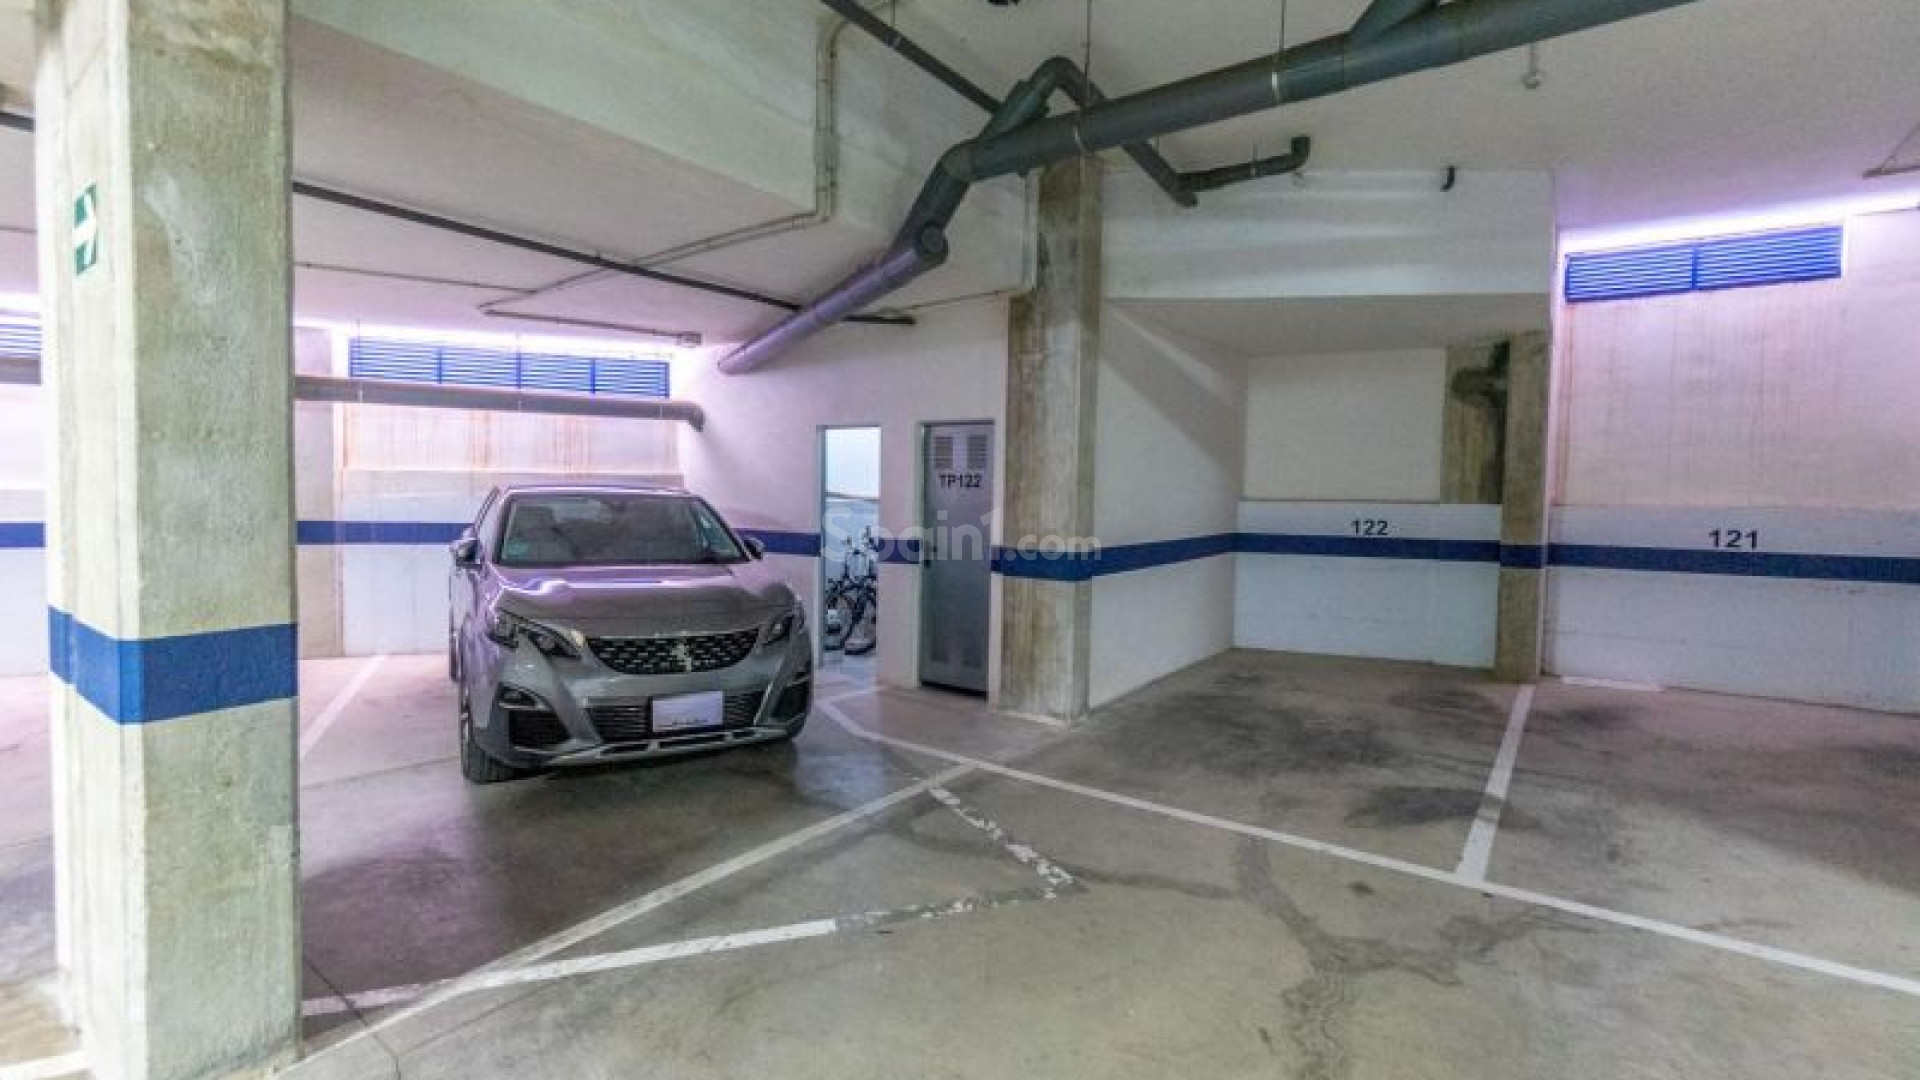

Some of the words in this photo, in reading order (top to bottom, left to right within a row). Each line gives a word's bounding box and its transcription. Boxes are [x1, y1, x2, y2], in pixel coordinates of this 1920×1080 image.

[939, 474, 982, 488] TP122
[1350, 519, 1389, 536] 122
[1708, 529, 1758, 549] 121
